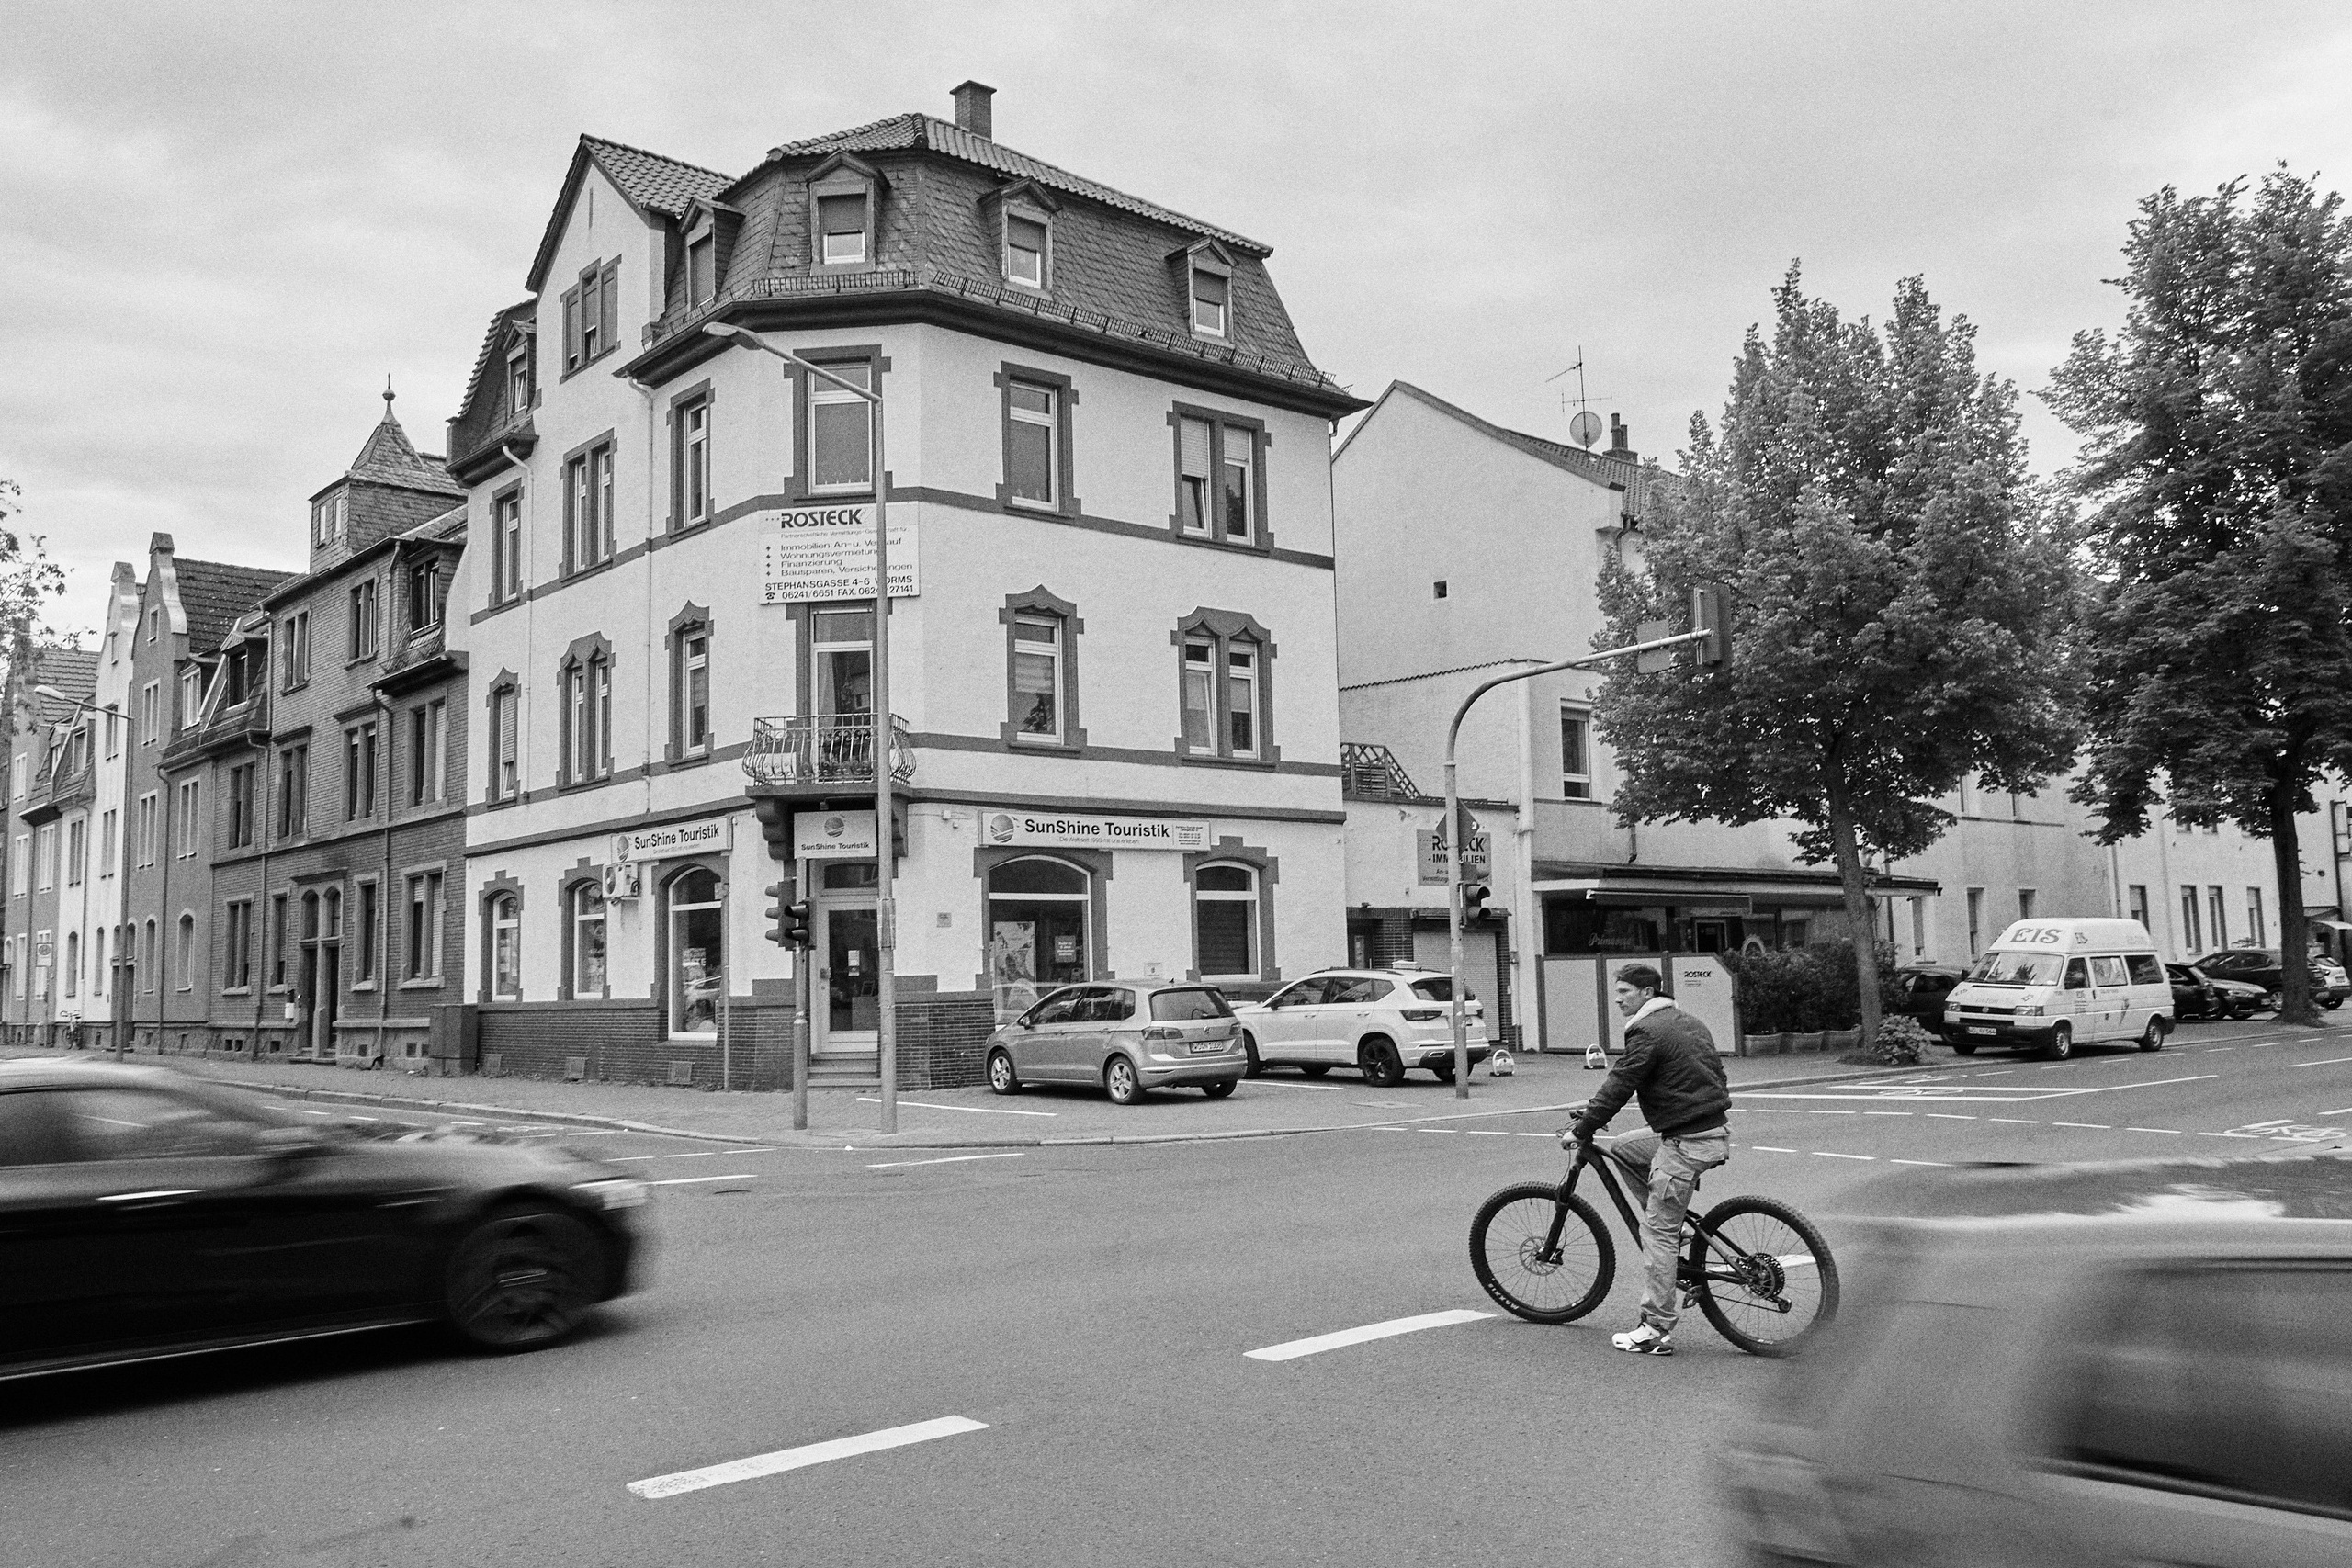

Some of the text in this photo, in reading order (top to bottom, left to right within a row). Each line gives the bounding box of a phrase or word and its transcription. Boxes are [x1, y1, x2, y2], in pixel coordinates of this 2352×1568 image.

[781, 509, 863, 529] ROSTECK
[781, 542, 831, 551] Immobilien
[865, 537, 902, 547] Veauf
[780, 549, 878, 560] Wohnungsvermietun
[781, 559, 843, 569] Finanzierung
[781, 568, 836, 577] Bausparen,
[765, 578, 850, 592] STEPHANSGASSE
[852, 577, 870, 586] 4-6
[1024, 818, 1101, 835] SunShine
[1105, 822, 1170, 838] Touristik
[634, 833, 676, 850] SunShine
[678, 823, 719, 843] Touristik
[1431, 836, 1485, 852] ROCK
[2008, 927, 2064, 944] EIS
[1684, 970, 1712, 978] ROSTECK
